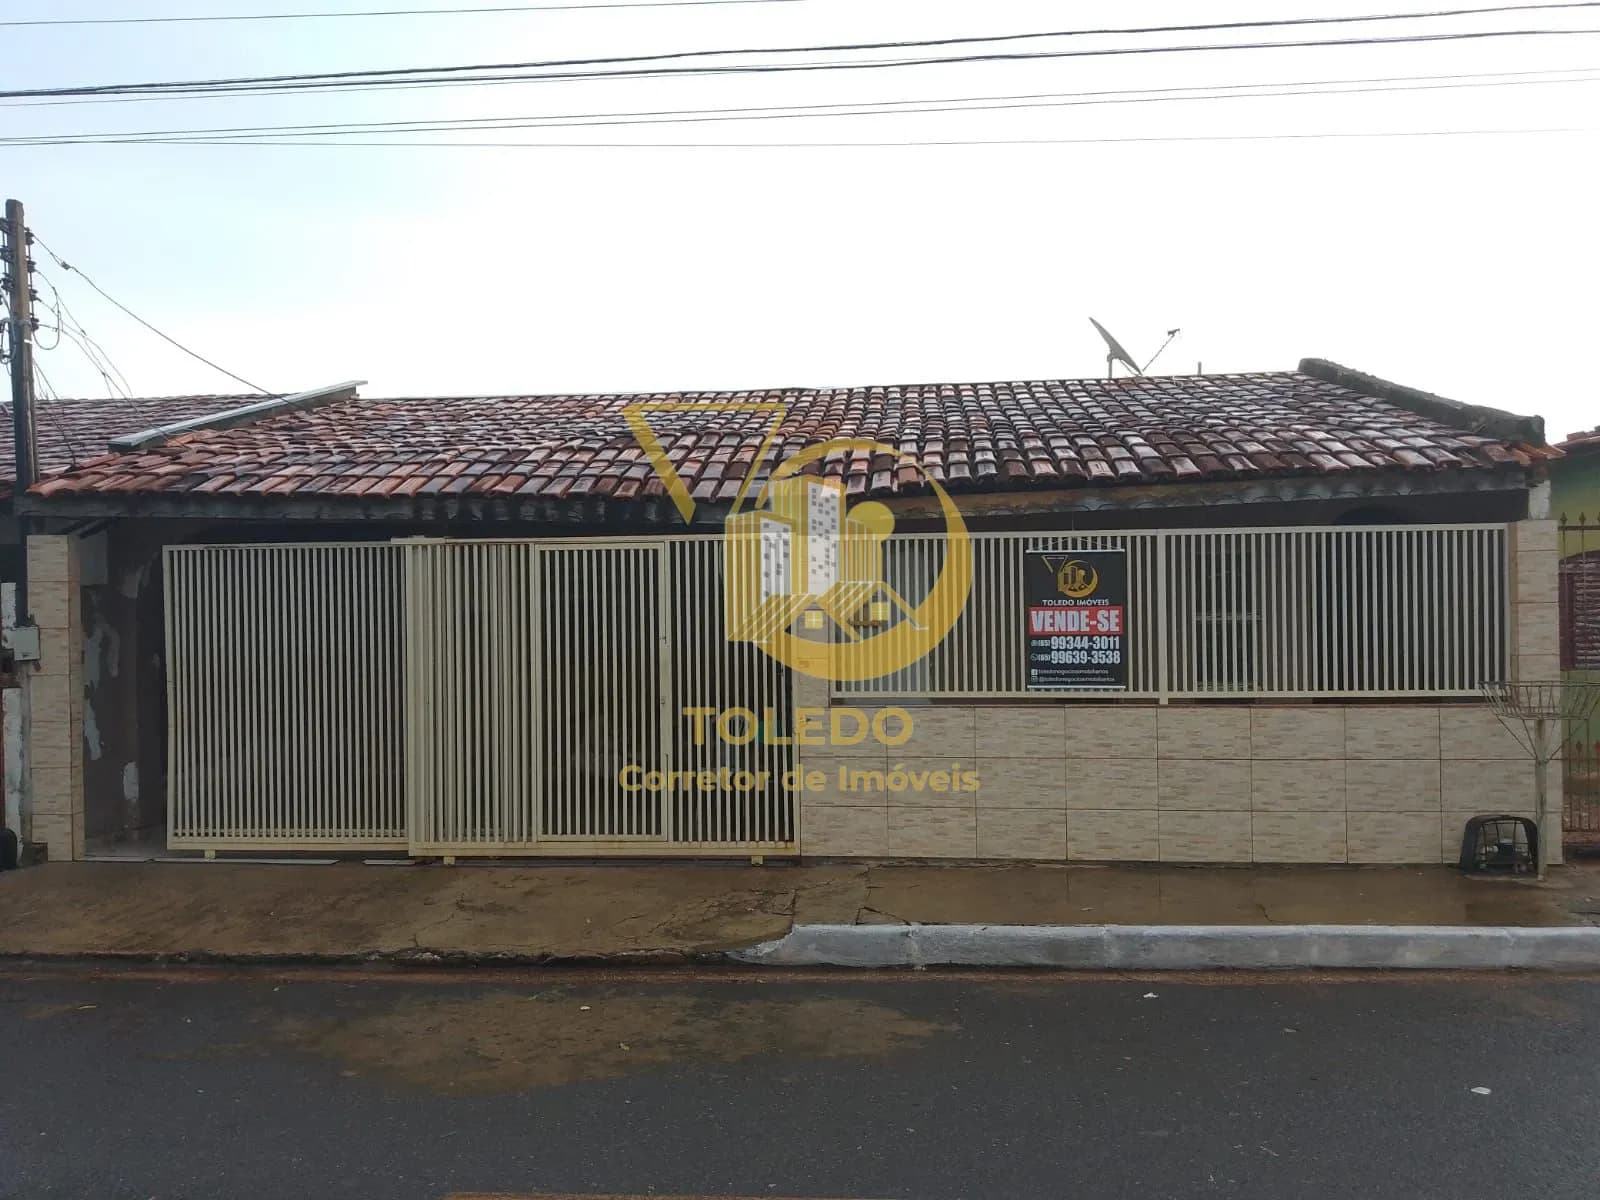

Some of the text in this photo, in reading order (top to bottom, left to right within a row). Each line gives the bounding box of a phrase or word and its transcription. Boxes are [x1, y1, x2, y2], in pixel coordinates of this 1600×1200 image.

[1031, 610, 1120, 632] VENDE-SE
[1051, 636, 1120, 650] 99344-3011
[1051, 650, 1121, 664] 99639-3538
